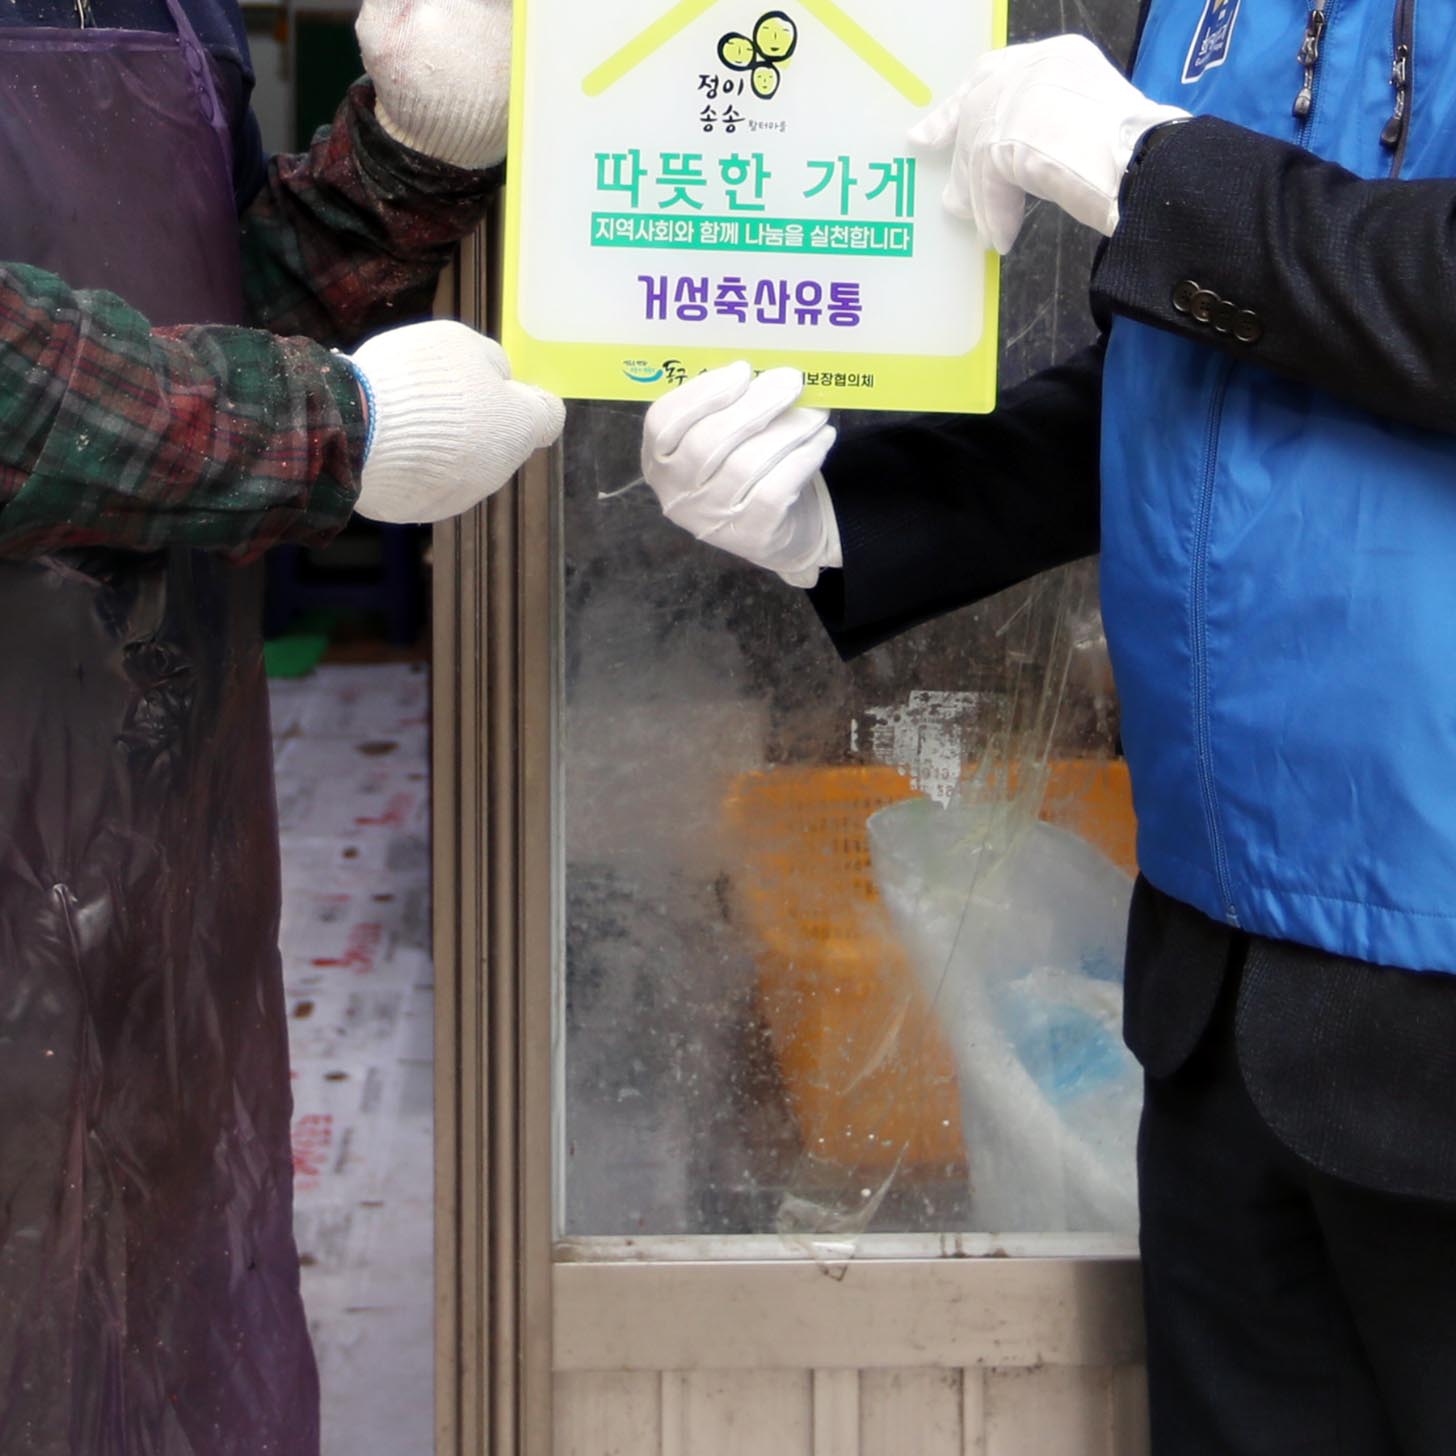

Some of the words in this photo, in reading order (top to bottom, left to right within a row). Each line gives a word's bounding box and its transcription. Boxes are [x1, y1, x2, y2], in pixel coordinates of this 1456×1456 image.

[697, 74, 744, 99] 정이
[700, 104, 745, 133] 송송
[595, 149, 772, 211] 따뜻한
[803, 155, 915, 217] 가게
[595, 217, 694, 243] 지역사회와
[700, 220, 738, 245] 함께
[745, 223, 804, 247] 나눔을
[810, 225, 910, 250] 실천합니다
[638, 275, 862, 327] 거성축산유통
[662, 359, 689, 386] 동구
